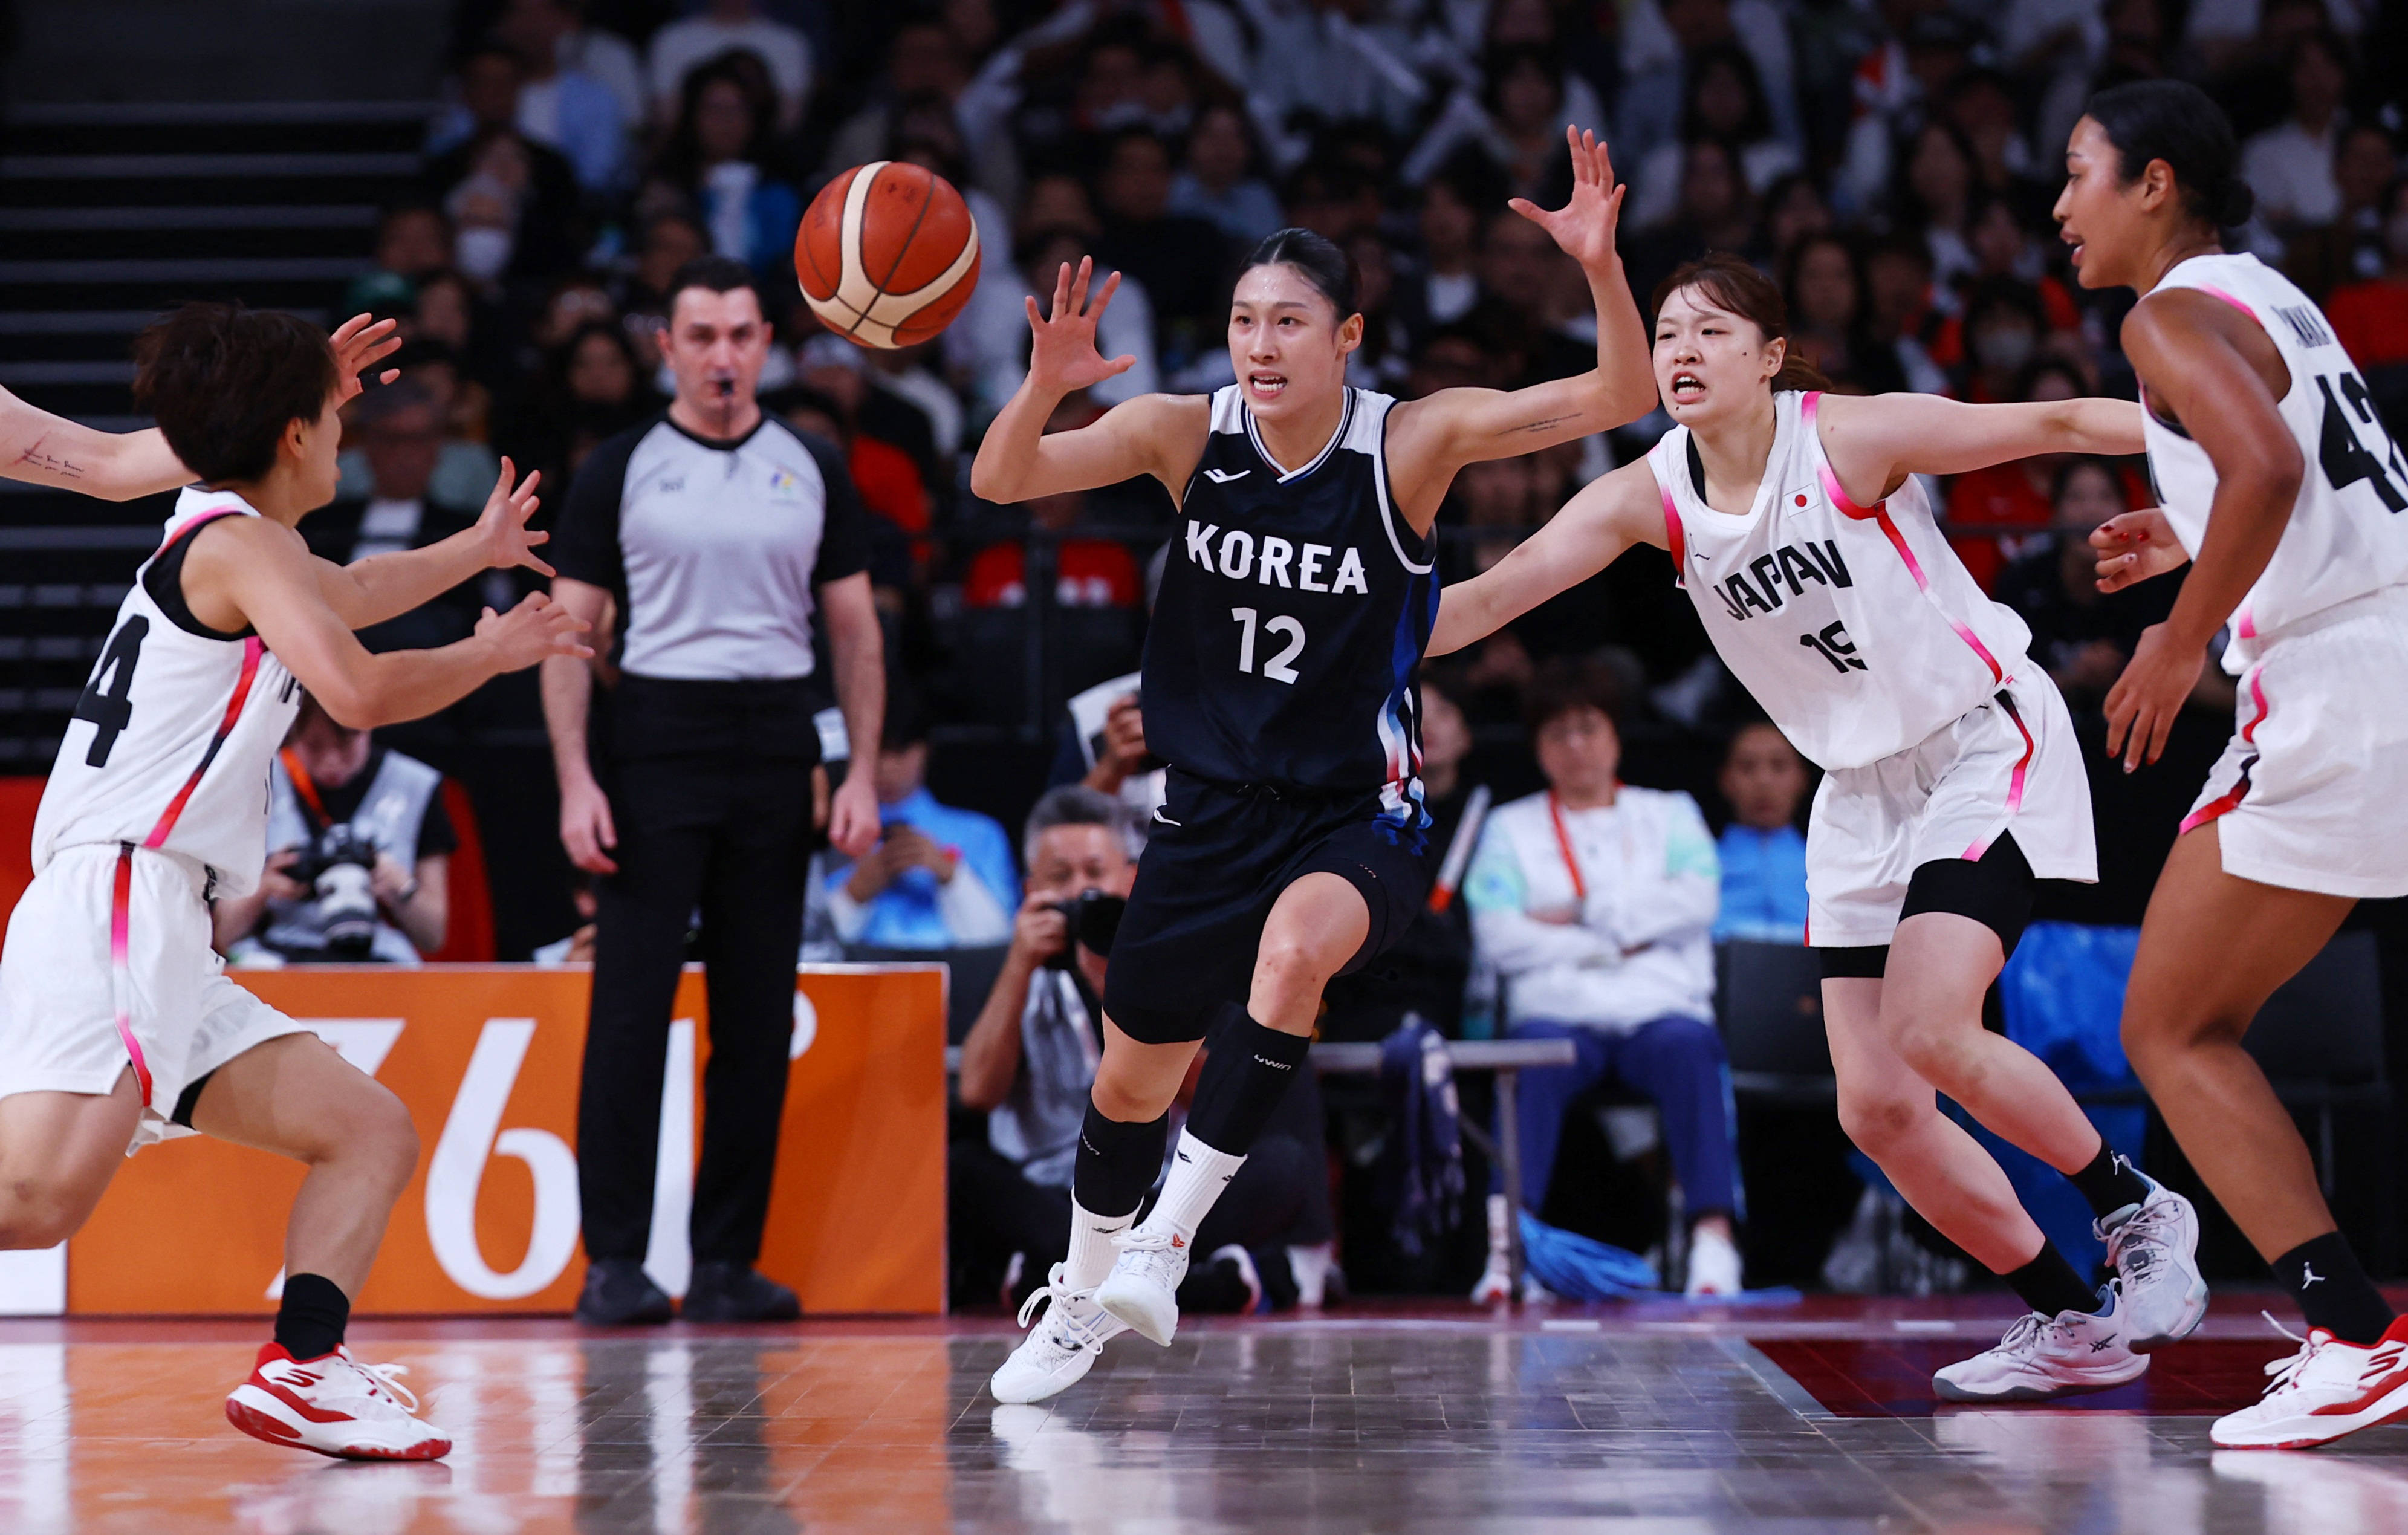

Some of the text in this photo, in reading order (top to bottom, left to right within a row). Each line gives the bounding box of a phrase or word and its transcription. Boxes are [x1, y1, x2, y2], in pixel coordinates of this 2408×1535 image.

[1184, 519, 1369, 595] KOREA
[1713, 539, 1854, 621] JAPAN
[1231, 607, 1306, 685] 12
